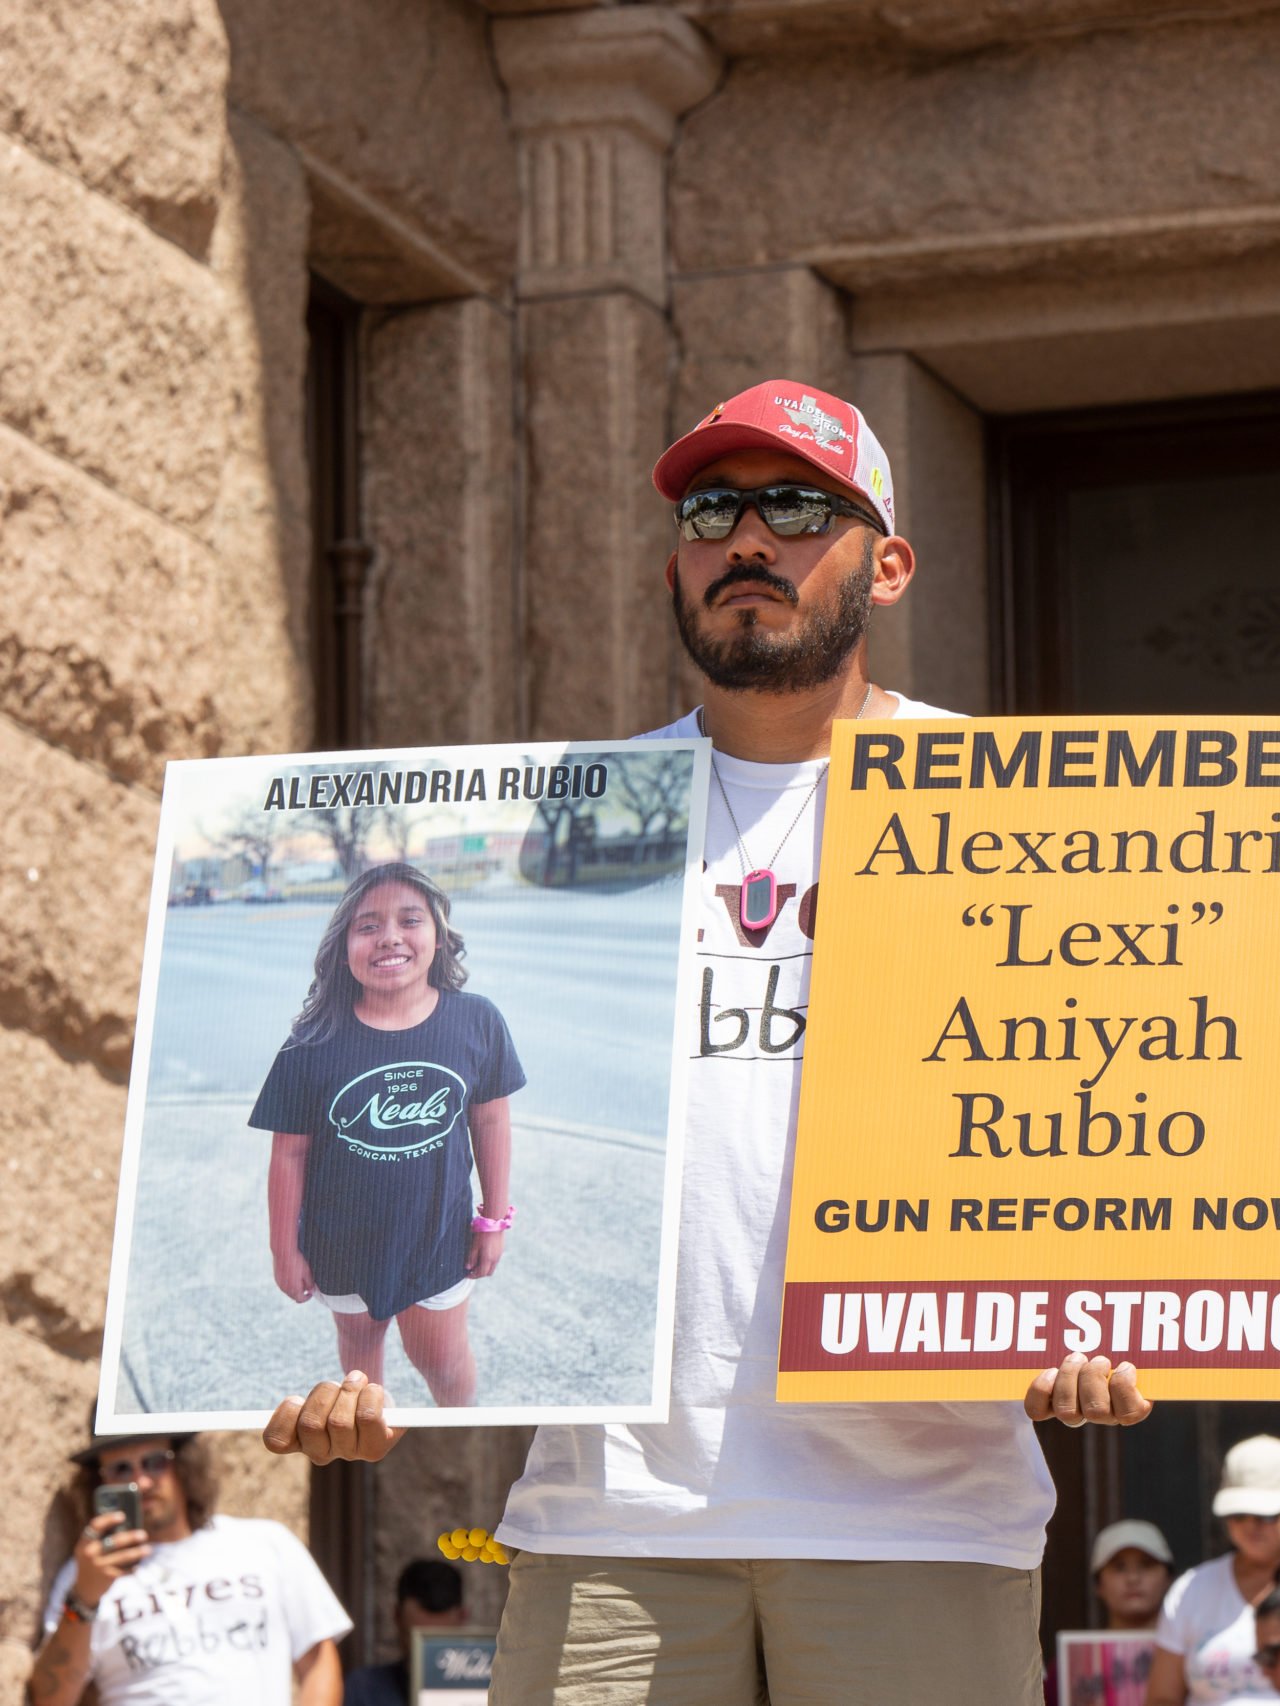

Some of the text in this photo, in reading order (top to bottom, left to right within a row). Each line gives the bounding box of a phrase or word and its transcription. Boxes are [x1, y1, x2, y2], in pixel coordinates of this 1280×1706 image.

[774, 396, 822, 417] UVALDE
[263, 763, 608, 811] ALEXANDRIA RUBIO
[961, 901, 1224, 967] “Lexi”
[921, 995, 1243, 1089] Aniyah
[384, 1069, 424, 1081] SINCE
[387, 1083, 418, 1094] 1926
[340, 1087, 451, 1130] Neals
[947, 1090, 1206, 1158] Rubio
[348, 1140, 444, 1162] CONCAN, TEXAS
[813, 1199, 929, 1233] GUN
[949, 1197, 1172, 1232] REFORM
[820, 1291, 1048, 1355] UVALDE
[116, 1572, 265, 1626] Lives
